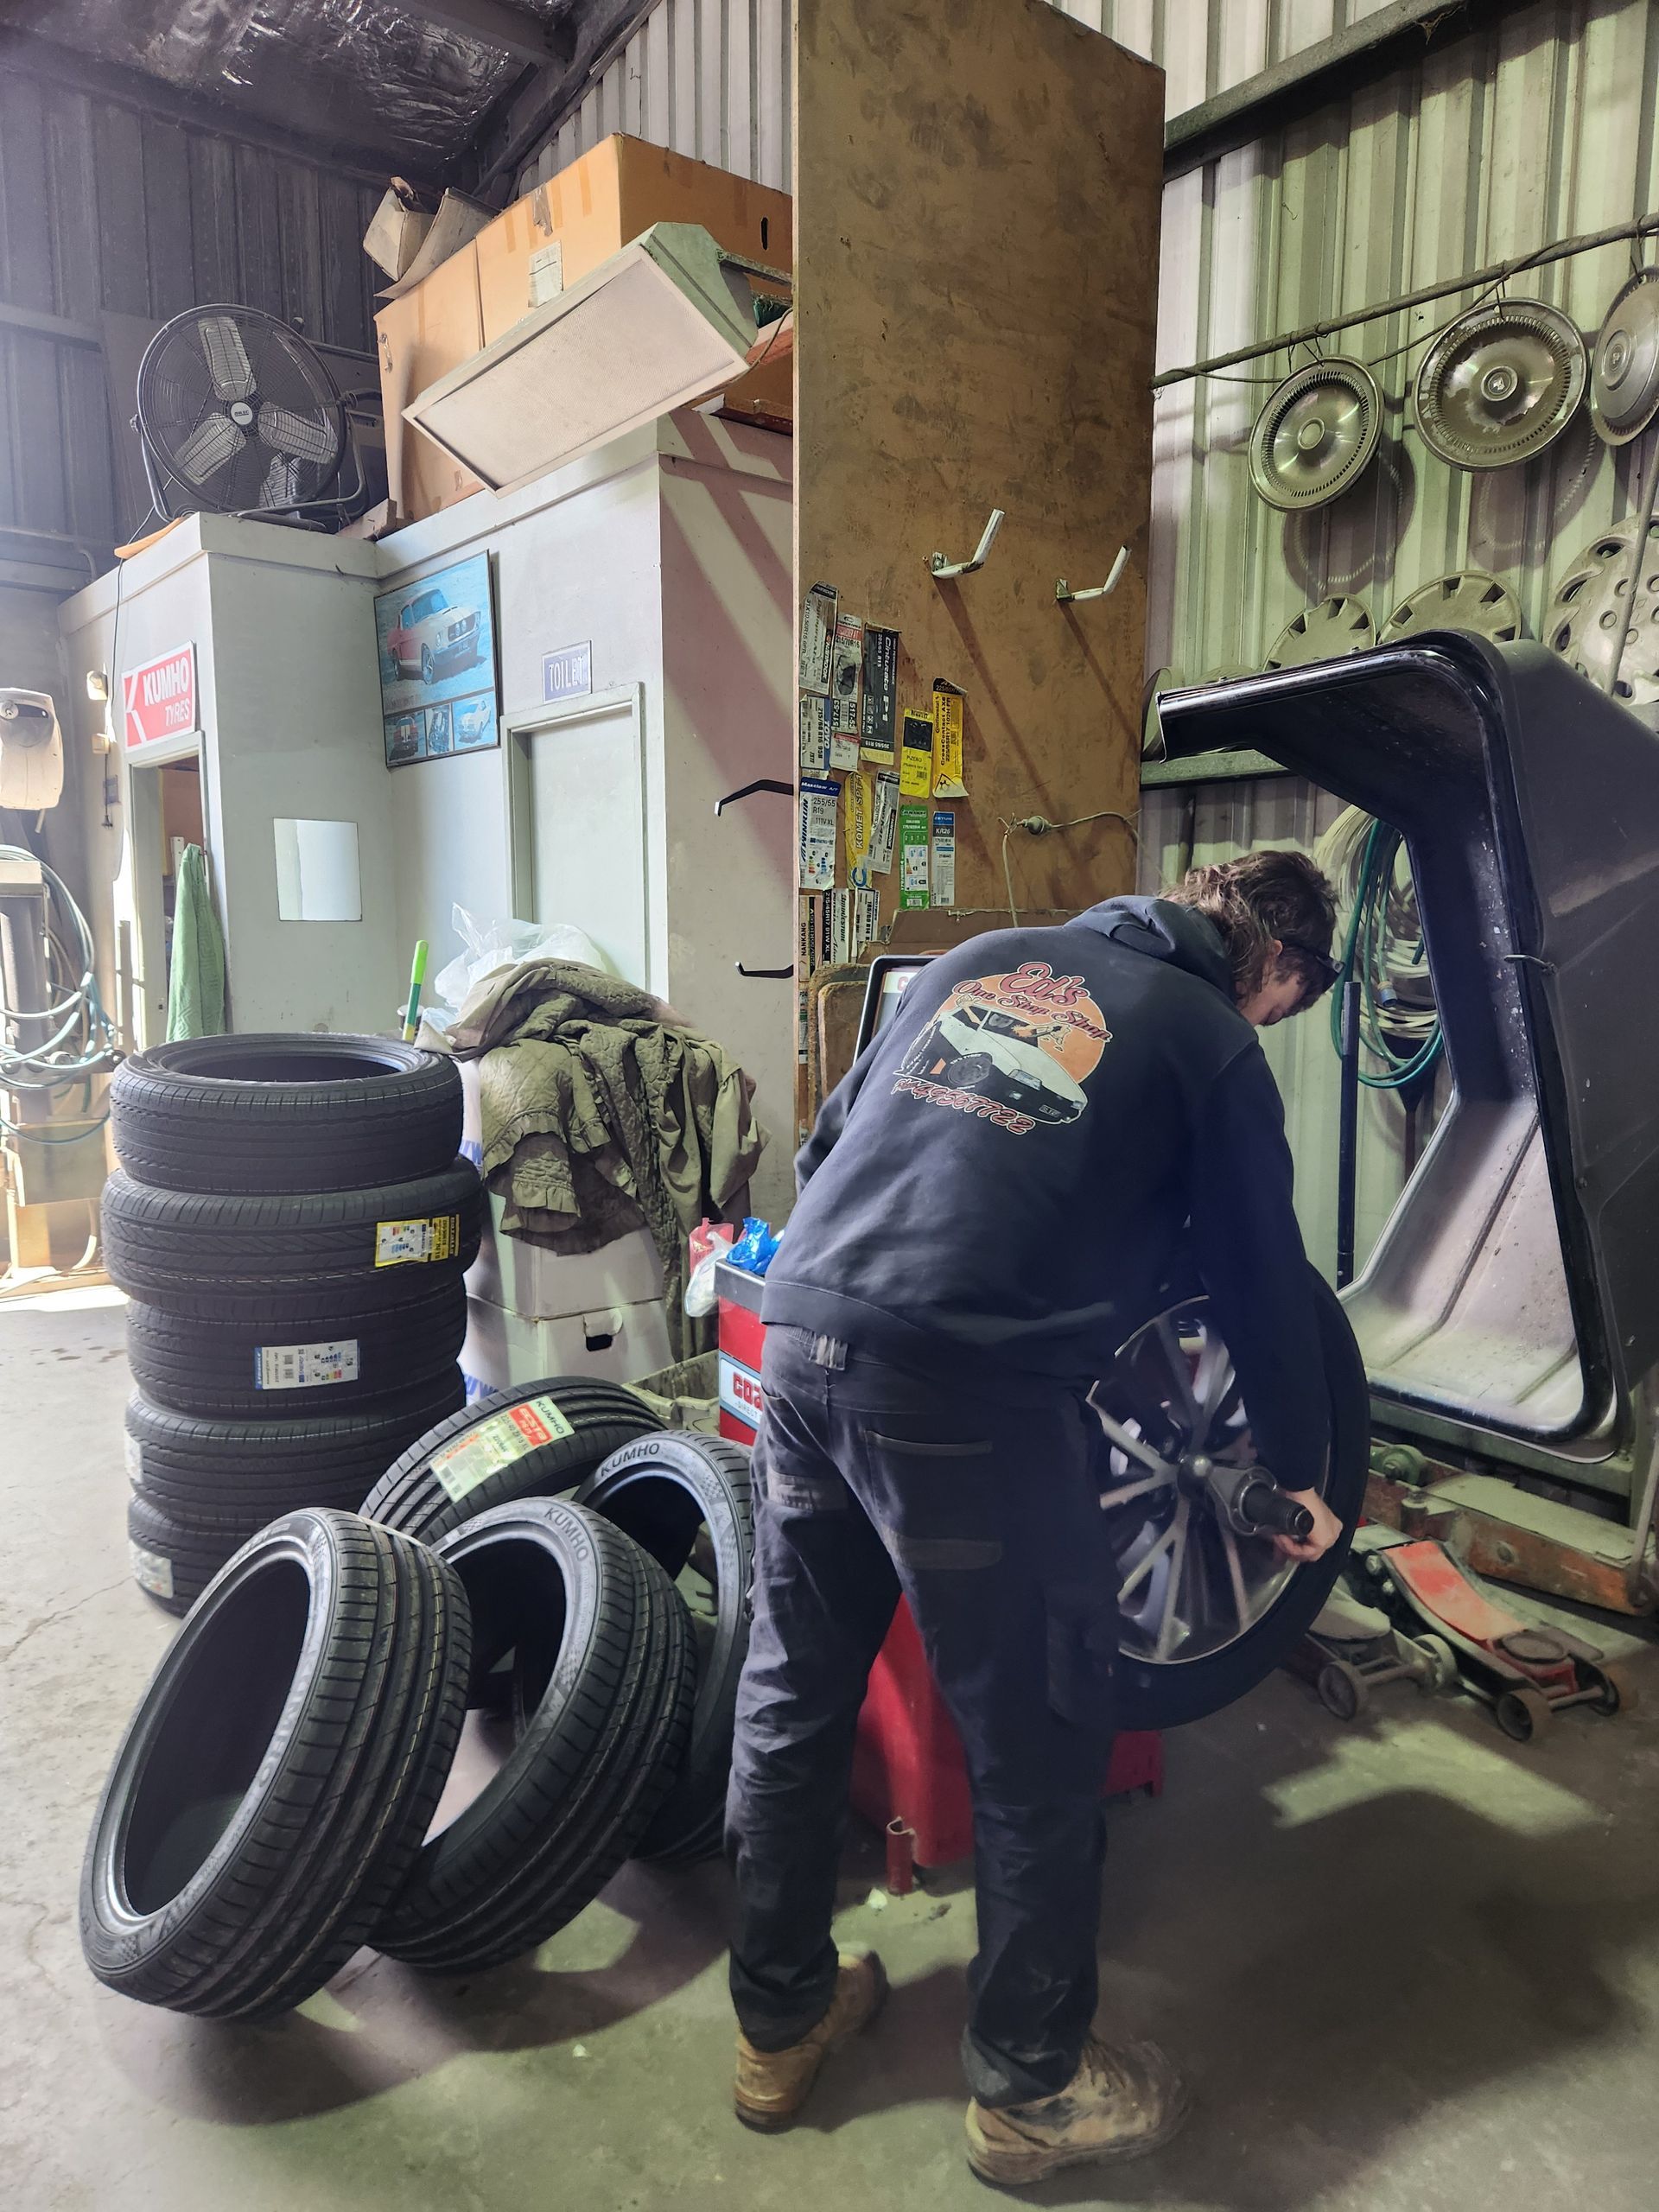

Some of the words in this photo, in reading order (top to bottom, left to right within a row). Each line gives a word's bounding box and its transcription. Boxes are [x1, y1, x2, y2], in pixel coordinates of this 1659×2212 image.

[143, 656, 189, 707] KUMHO
[548, 655, 584, 692] TOILET
[165, 697, 190, 727] TYRES
[812, 797, 836, 808] 255/55
[825, 944, 830, 953] XL
[998, 962, 1090, 1007] Ed's
[952, 981, 995, 1001] One
[997, 994, 1051, 1016] Stop
[1051, 1010, 1114, 1042] Shop
[535, 1400, 565, 1435] KUMHO
[601, 1443, 660, 1477] KUMHO
[543, 1507, 588, 1561] KUMHO
